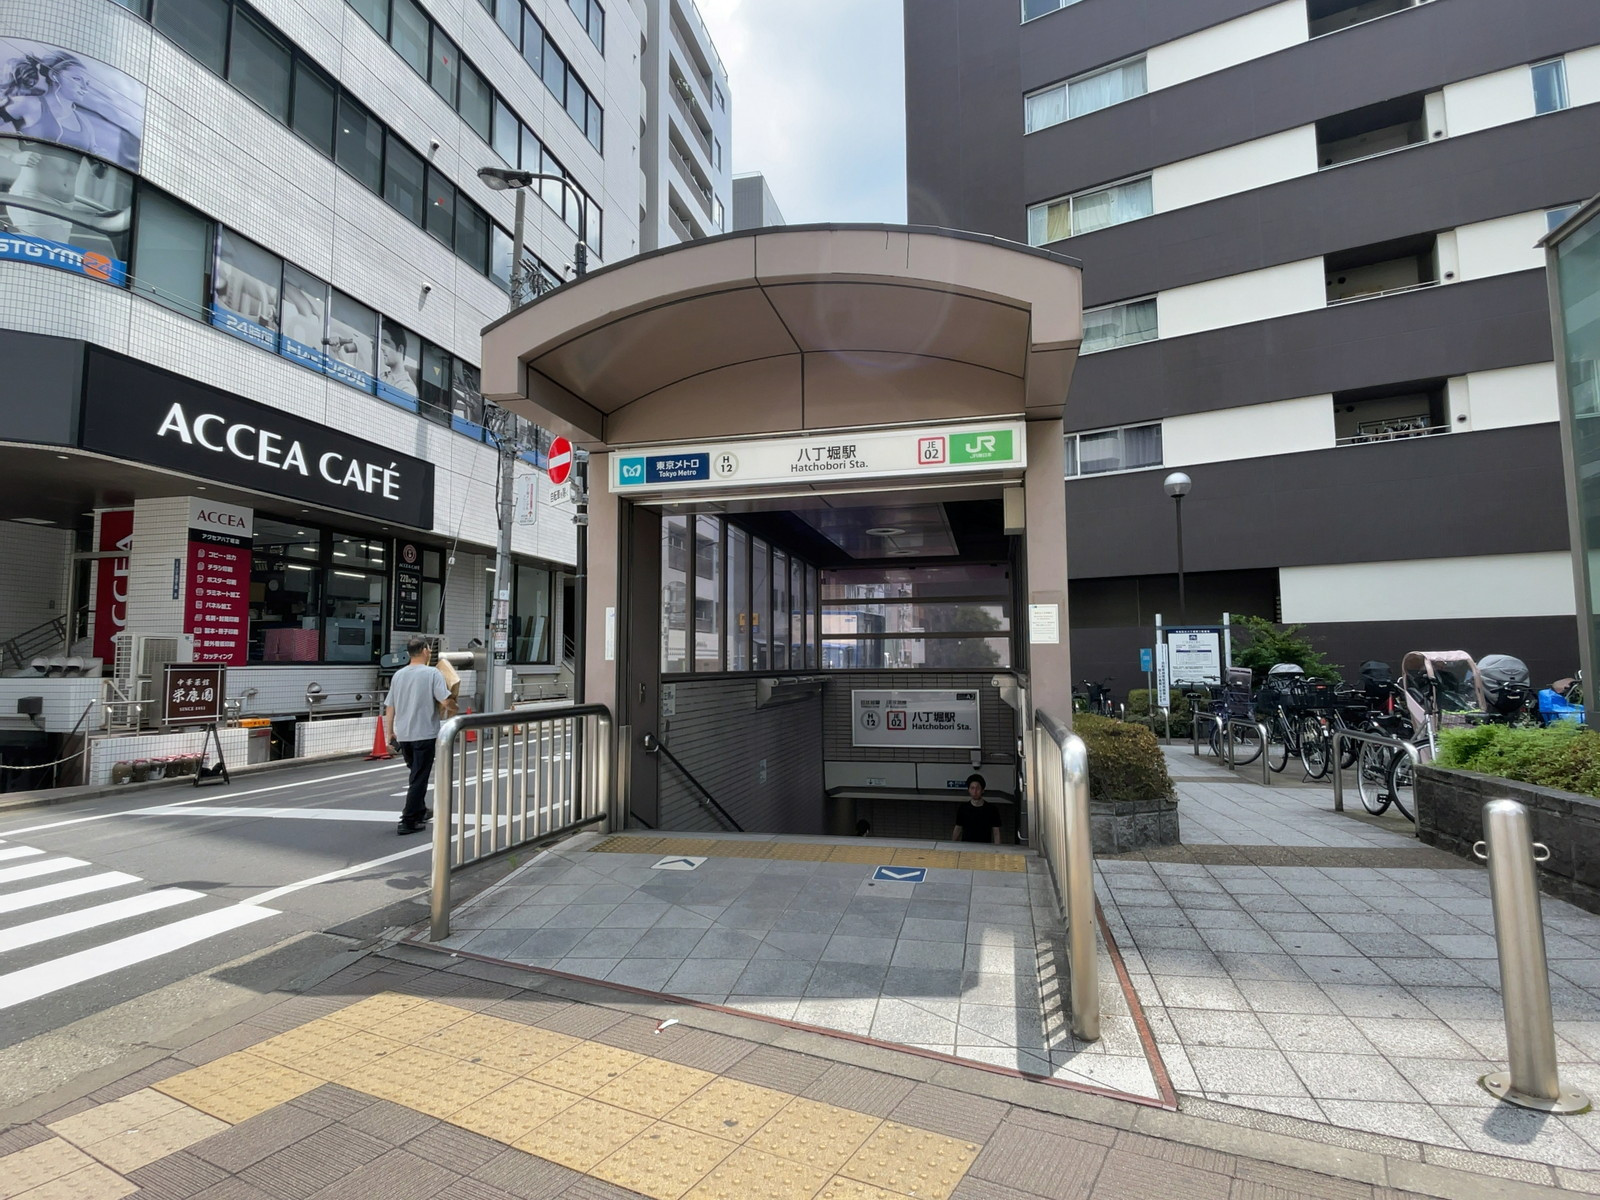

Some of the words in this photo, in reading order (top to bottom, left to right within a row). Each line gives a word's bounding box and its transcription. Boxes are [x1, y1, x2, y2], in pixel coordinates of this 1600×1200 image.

[928, 441, 936, 449] JE
[965, 436, 996, 453] JR
[157, 402, 309, 476] ACCEA
[319, 452, 400, 500] CAFÉ
[798, 445, 856, 462] 八丁堀駅
[924, 449, 939, 459] 02
[656, 459, 699, 471] 東京メトロ
[721, 464, 733, 472] 12
[791, 461, 846, 472] Hatchobori
[850, 460, 869, 469] Sta.
[660, 470, 677, 478] Tokyo
[197, 510, 245, 528] ACCEA
[912, 712, 955, 722] 八丁堀駅
[891, 719, 902, 727] 02
